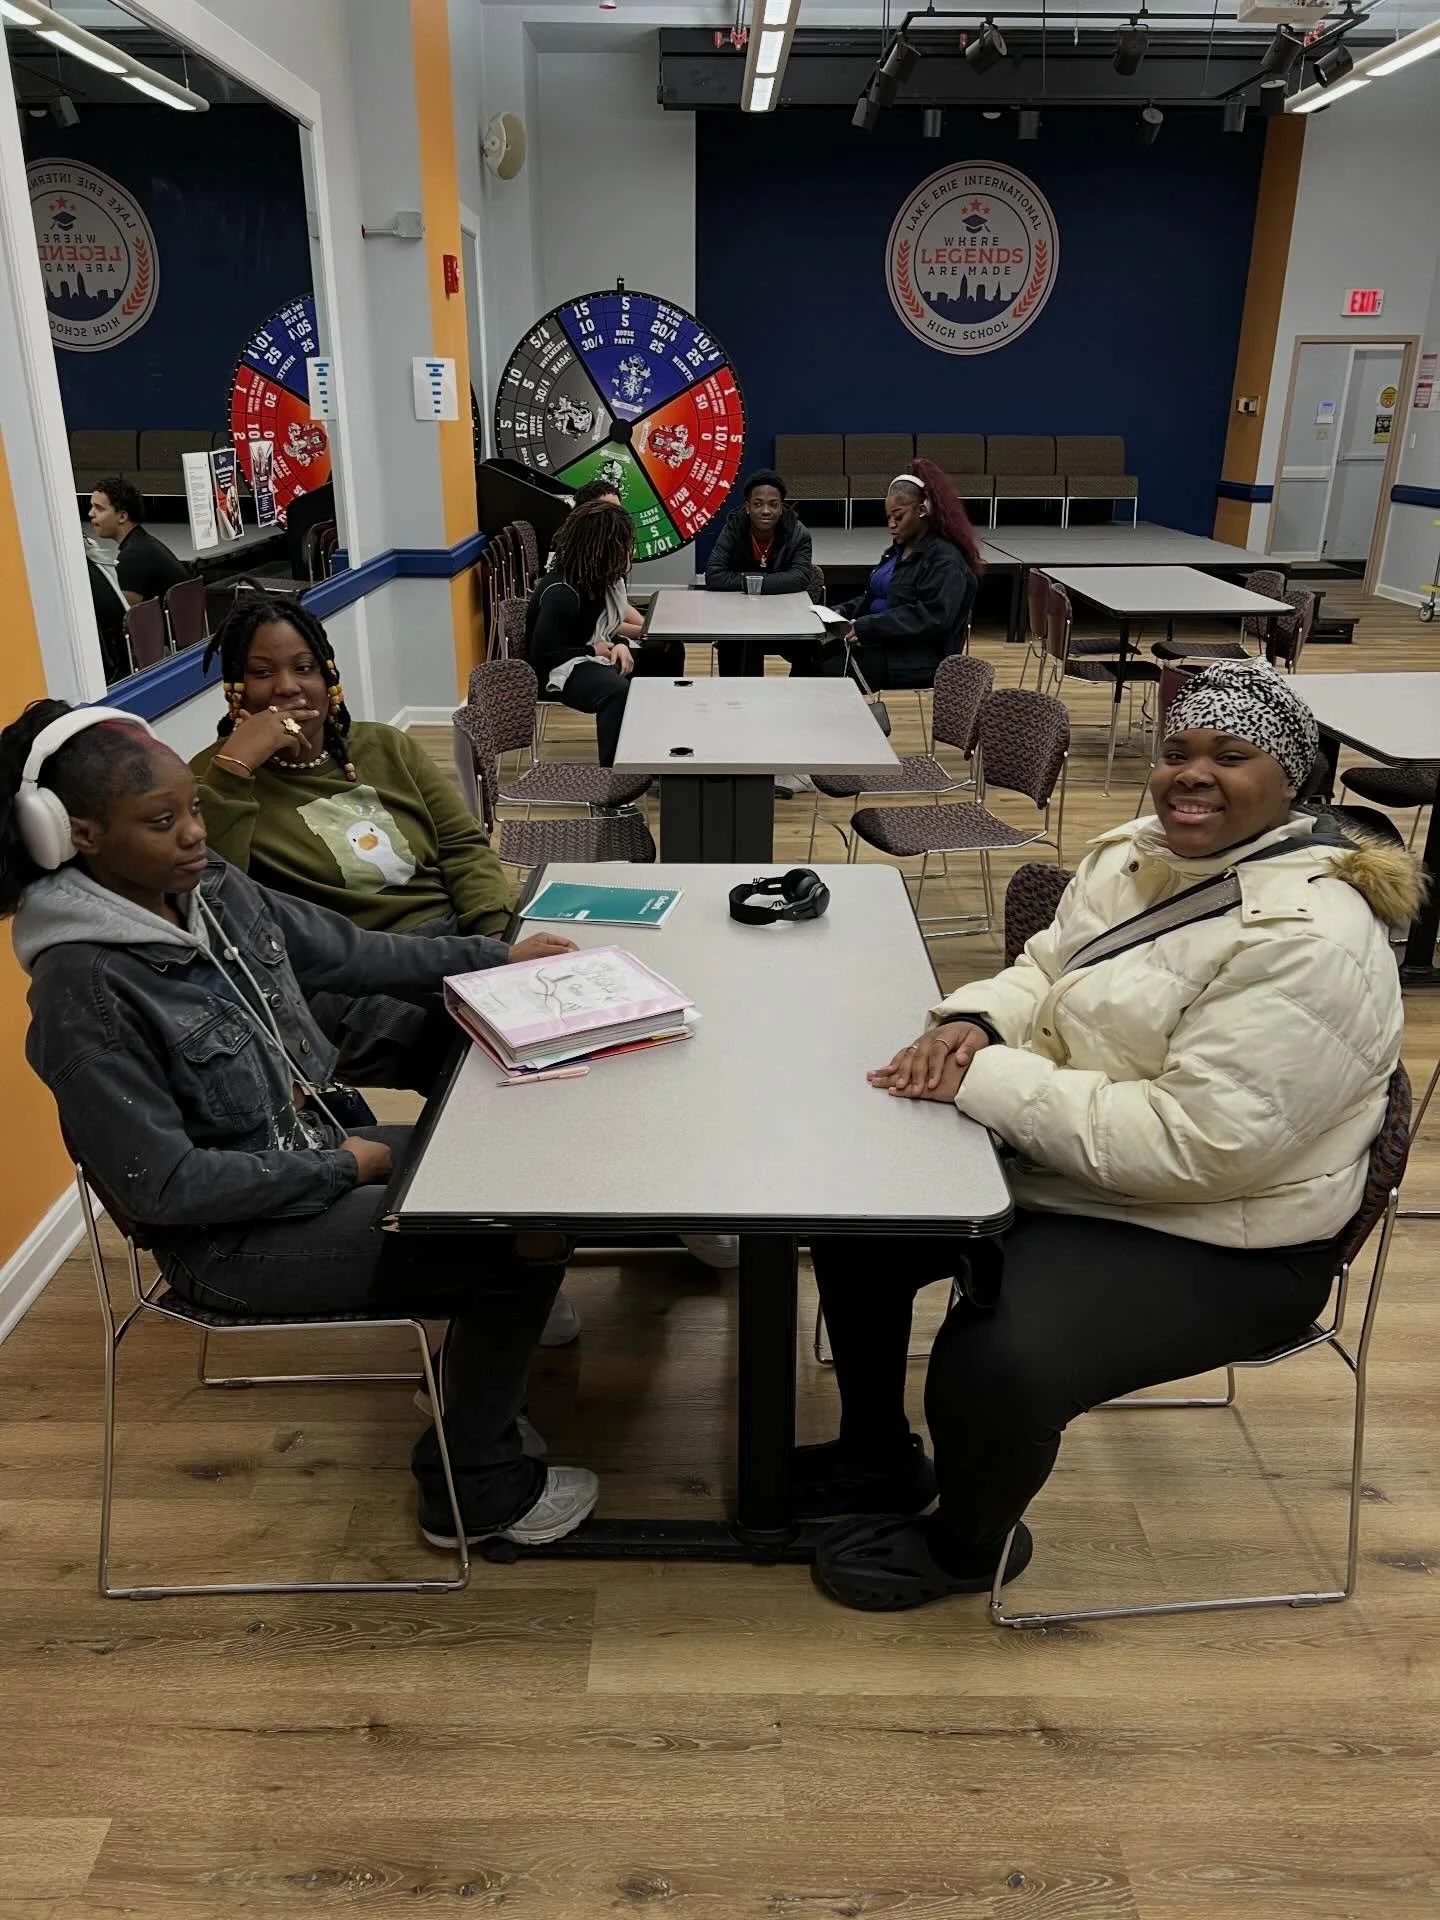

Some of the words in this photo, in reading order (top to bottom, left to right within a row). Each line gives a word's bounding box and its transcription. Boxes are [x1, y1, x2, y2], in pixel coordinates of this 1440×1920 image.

[906, 200, 930, 231] LAKE
[932, 179, 959, 200] ERIE
[964, 175, 1043, 231] INTERNATIONAL
[944, 237, 999, 246] WHERE
[921, 248, 1024, 264] LEGENDS
[928, 266, 958, 275] ARE
[968, 266, 1011, 275] MADE
[621, 297, 630, 310] 5
[1350, 291, 1377, 313] EXIT
[573, 301, 590, 319] 15
[579, 319, 595, 334] 10
[621, 314, 629, 327] 5
[926, 319, 956, 339] HIGH
[963, 320, 1009, 340] SCHOOL
[649, 339, 665, 354] 25
[685, 348, 704, 367] 25
[507, 368, 523, 387] 10
[522, 377, 535, 390] 5
[723, 386, 736, 396] 1
[694, 393, 709, 411] 50
[499, 419, 513, 429] 5
[701, 432, 712, 441] 0
[731, 433, 742, 443] 5
[536, 453, 549, 467] 40
[718, 478, 732, 490] 4
[680, 500, 697, 518] 20
[650, 525, 660, 538] 5
